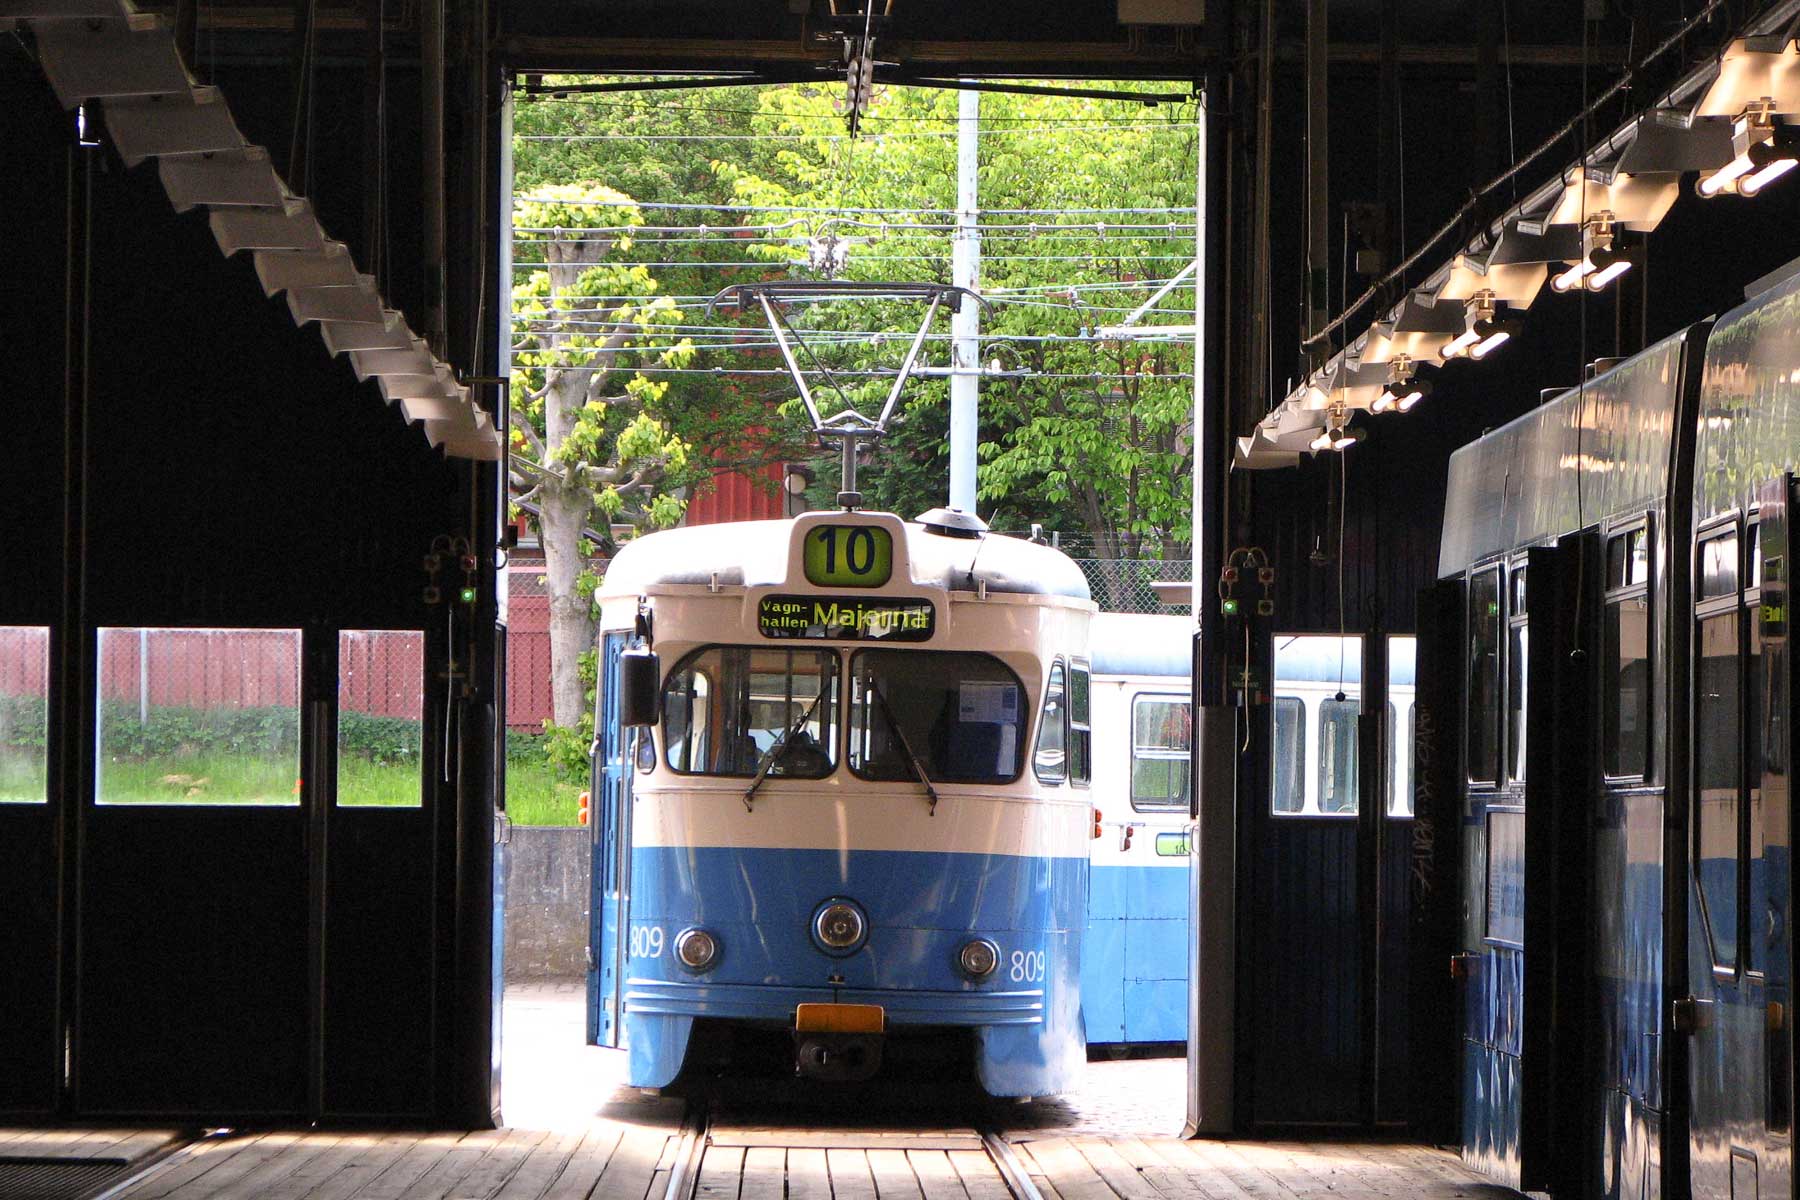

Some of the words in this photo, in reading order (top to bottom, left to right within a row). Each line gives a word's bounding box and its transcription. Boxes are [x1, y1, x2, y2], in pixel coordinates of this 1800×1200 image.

[818, 526, 875, 575] 10
[761, 616, 809, 628] hallen
[813, 602, 929, 630] Majorna
[630, 926, 664, 958] 809
[1010, 950, 1046, 982] 809
